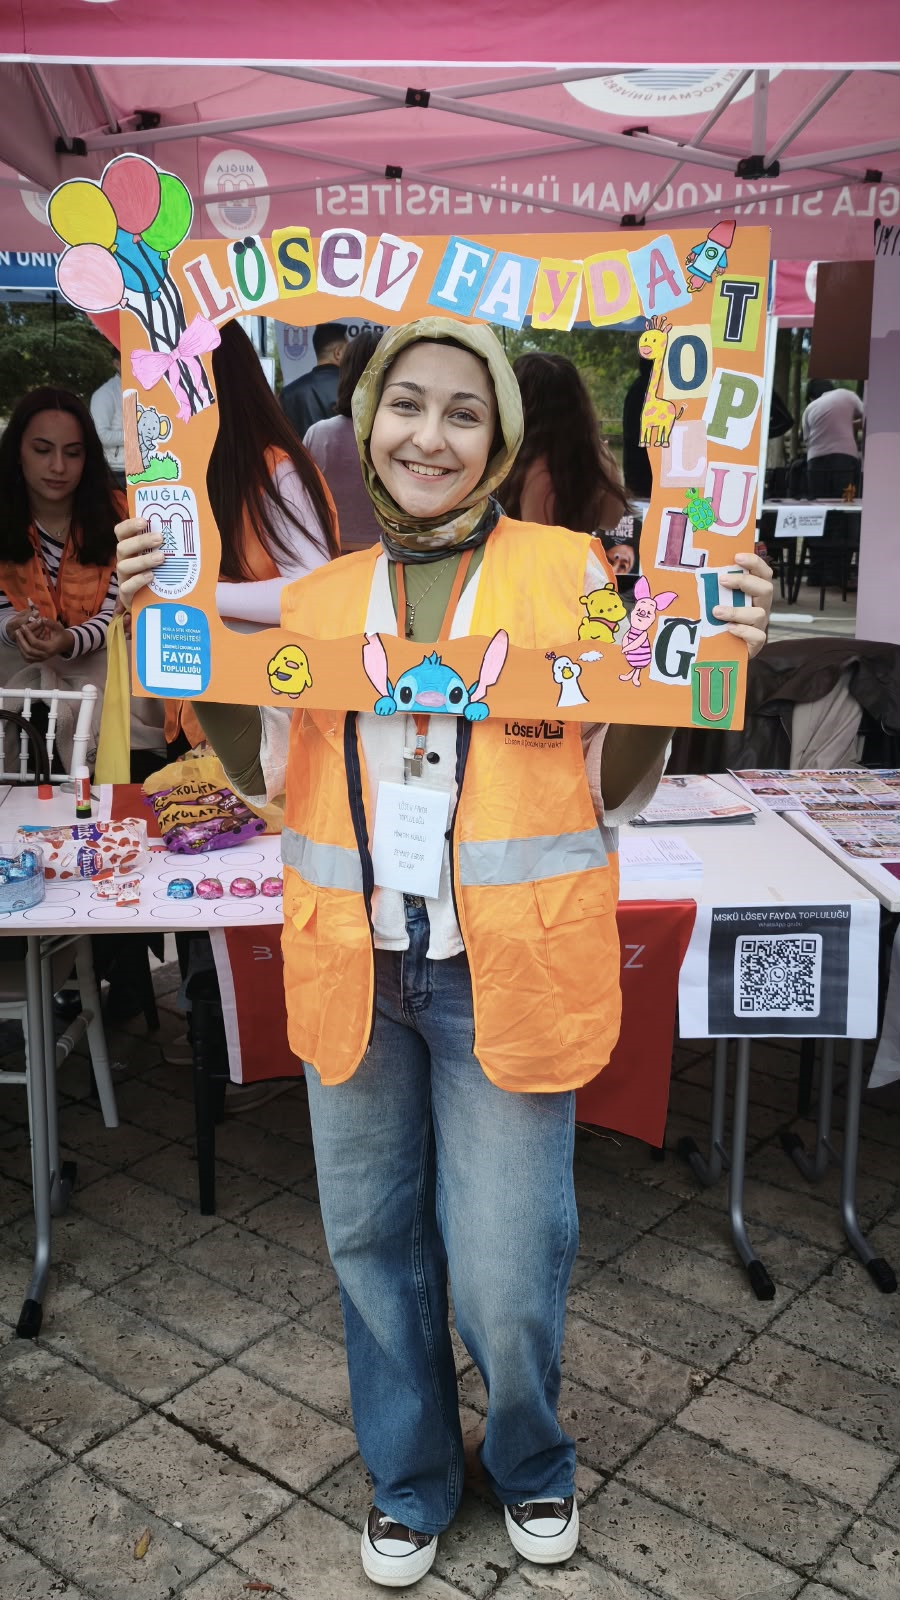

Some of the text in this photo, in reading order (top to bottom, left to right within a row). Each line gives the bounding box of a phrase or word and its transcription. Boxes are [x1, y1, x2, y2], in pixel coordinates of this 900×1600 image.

[138, 487, 191, 501] MUĞLA
[162, 651, 202, 665] FAYDA
[162, 664, 201, 674] TOPLULUĞU
[504, 720, 545, 739] LÖSEV
[713, 909, 849, 922] MSKÜ LÖSEV FAYDA TOPLULUĞU
